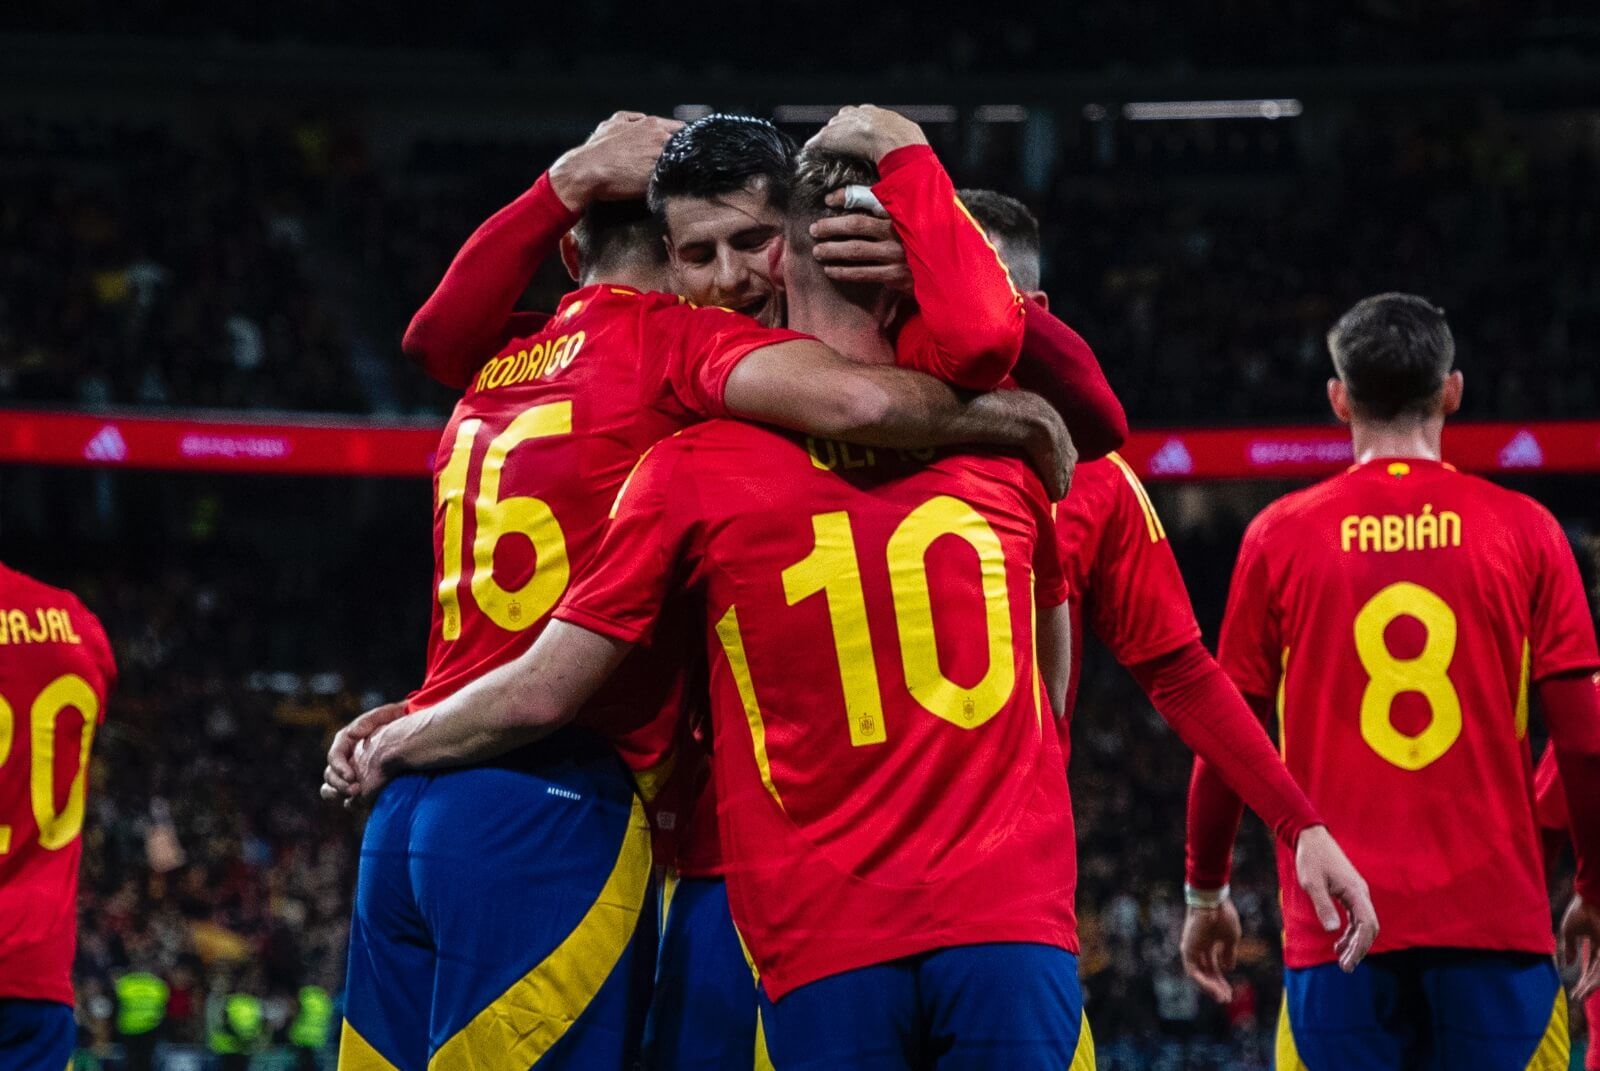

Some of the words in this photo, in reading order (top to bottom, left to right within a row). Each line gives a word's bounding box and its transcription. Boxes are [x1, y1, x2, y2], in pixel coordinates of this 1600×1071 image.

[475, 330, 586, 393] RODRIGO
[438, 400, 573, 642] 16
[1340, 503, 1462, 552] FABIÁN
[781, 496, 1015, 748] 10
[1354, 581, 1463, 771] 8
[0, 673, 99, 855] 0
